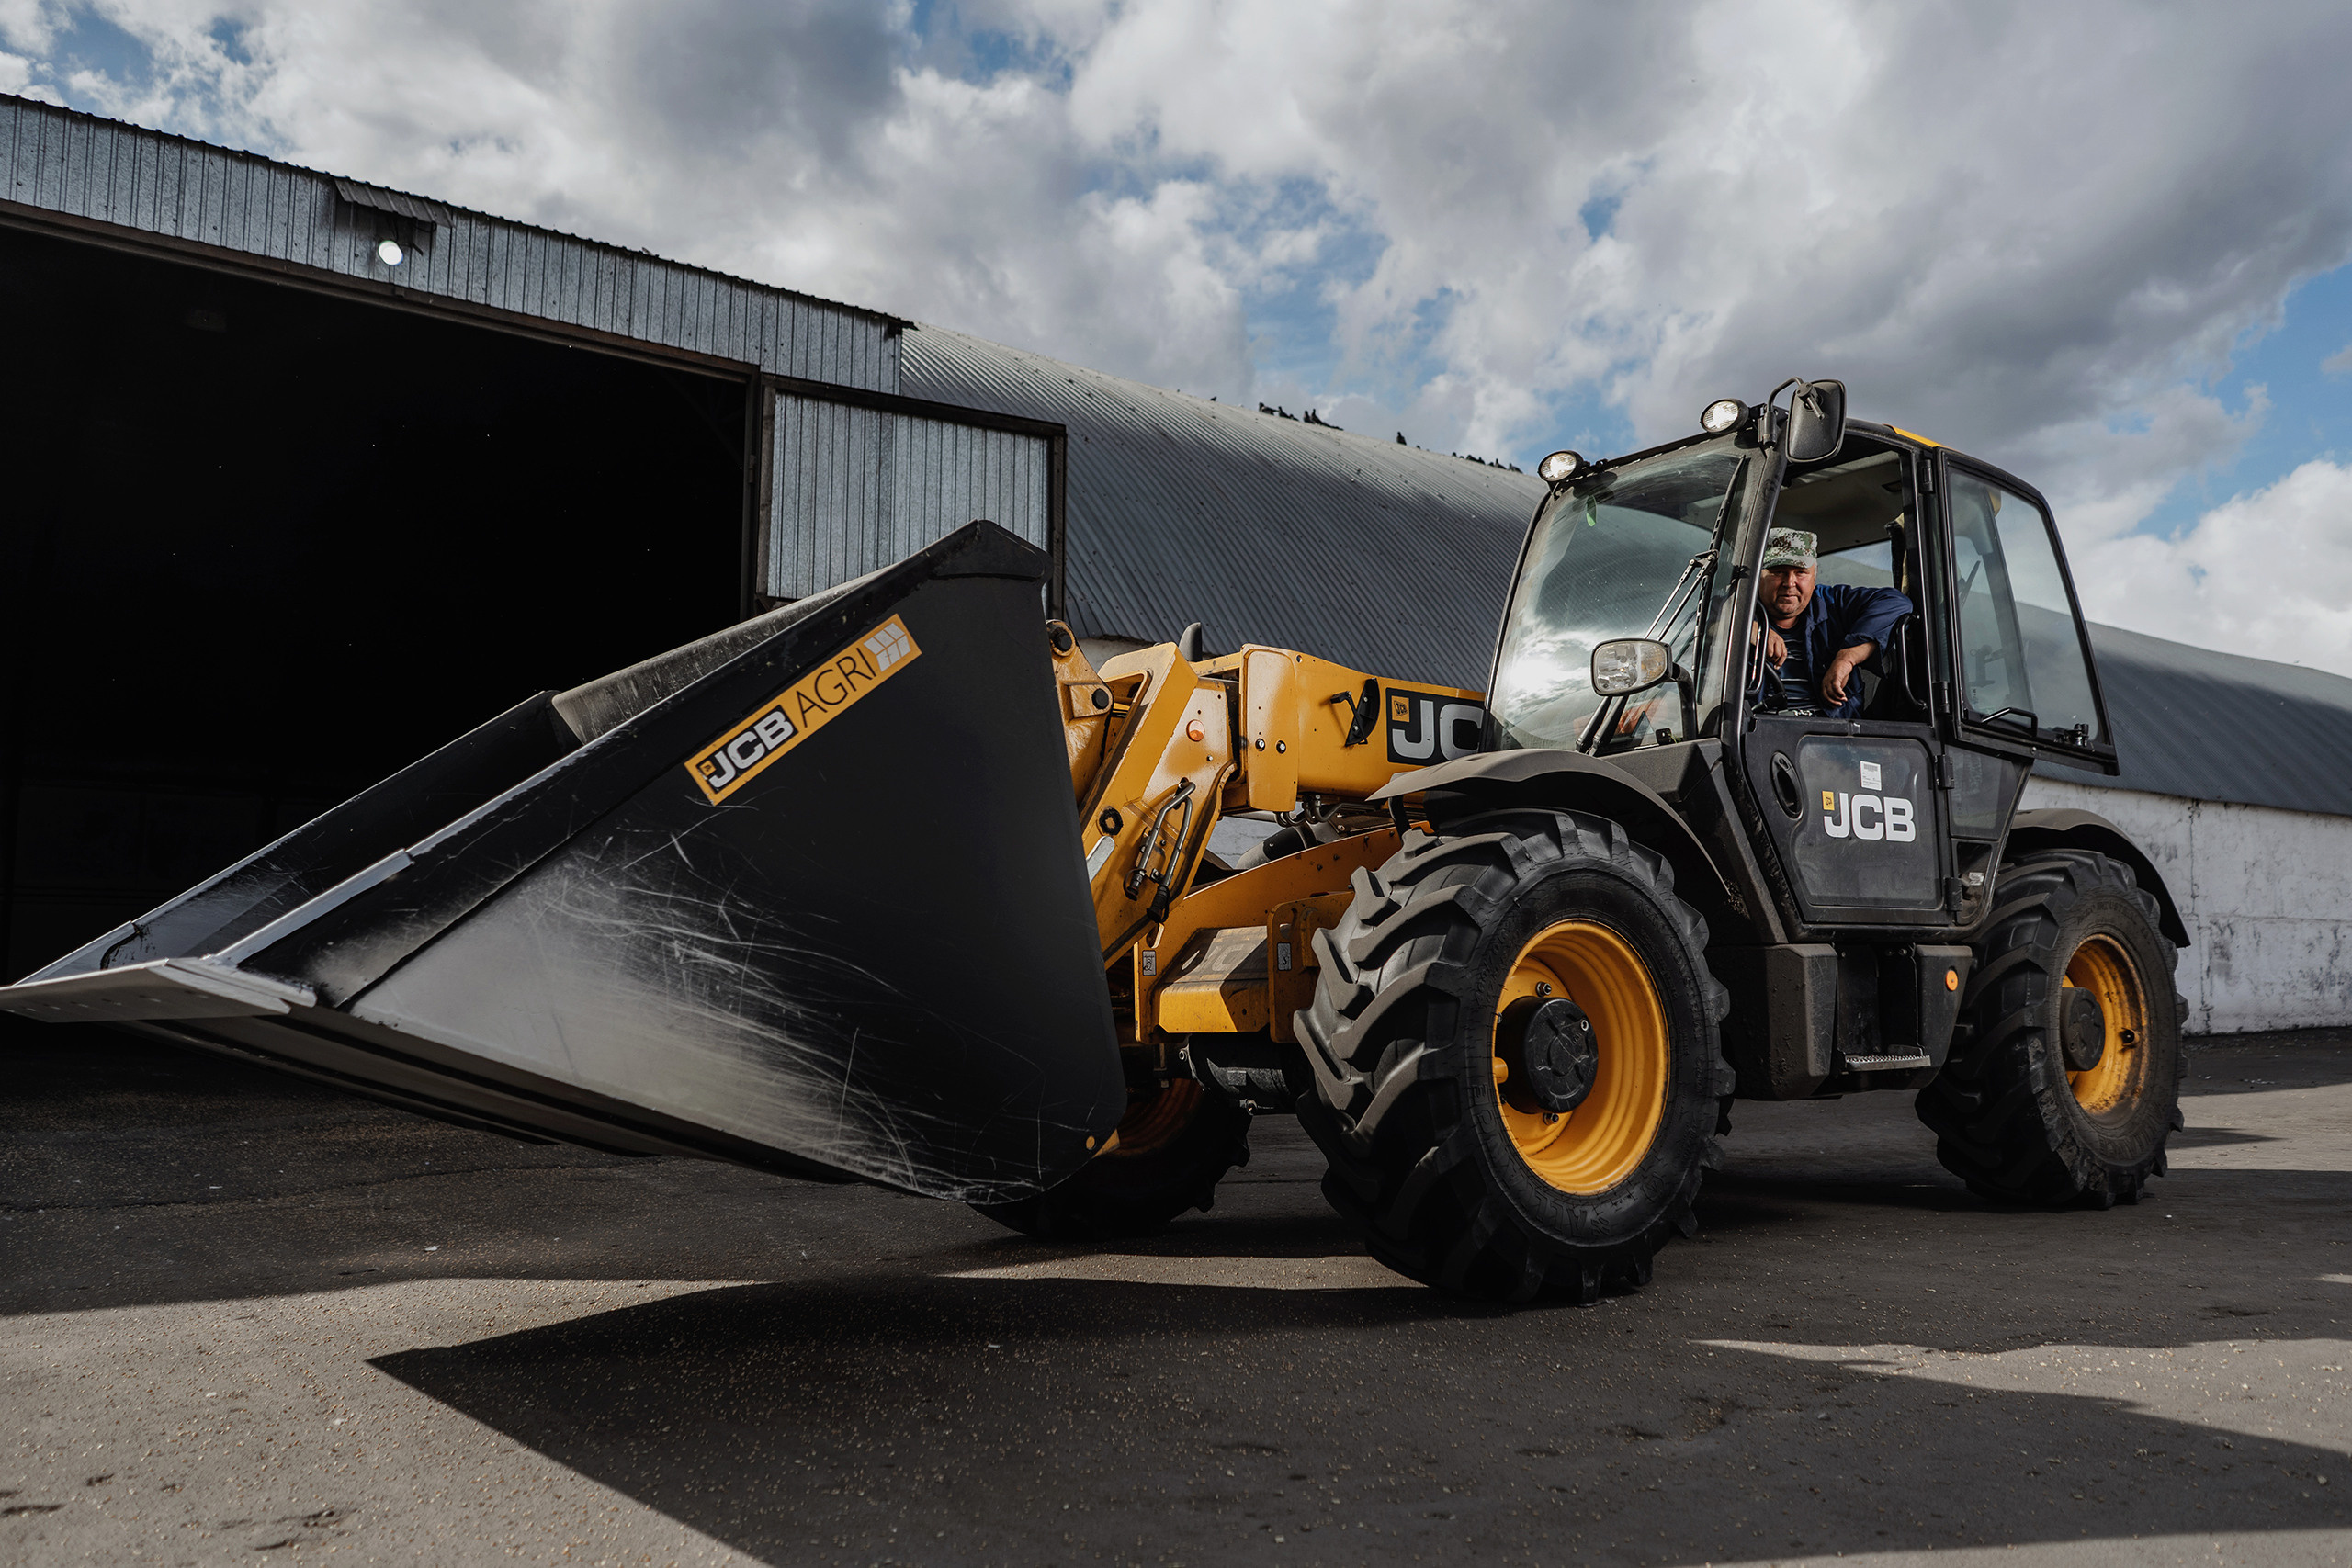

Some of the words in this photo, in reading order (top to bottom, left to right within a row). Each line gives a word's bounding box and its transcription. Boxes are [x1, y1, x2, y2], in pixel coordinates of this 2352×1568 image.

[708, 710, 794, 788] JCB
[796, 647, 876, 728] AGRI
[1392, 699, 1485, 761] JC
[1824, 792, 1917, 843] JCB
